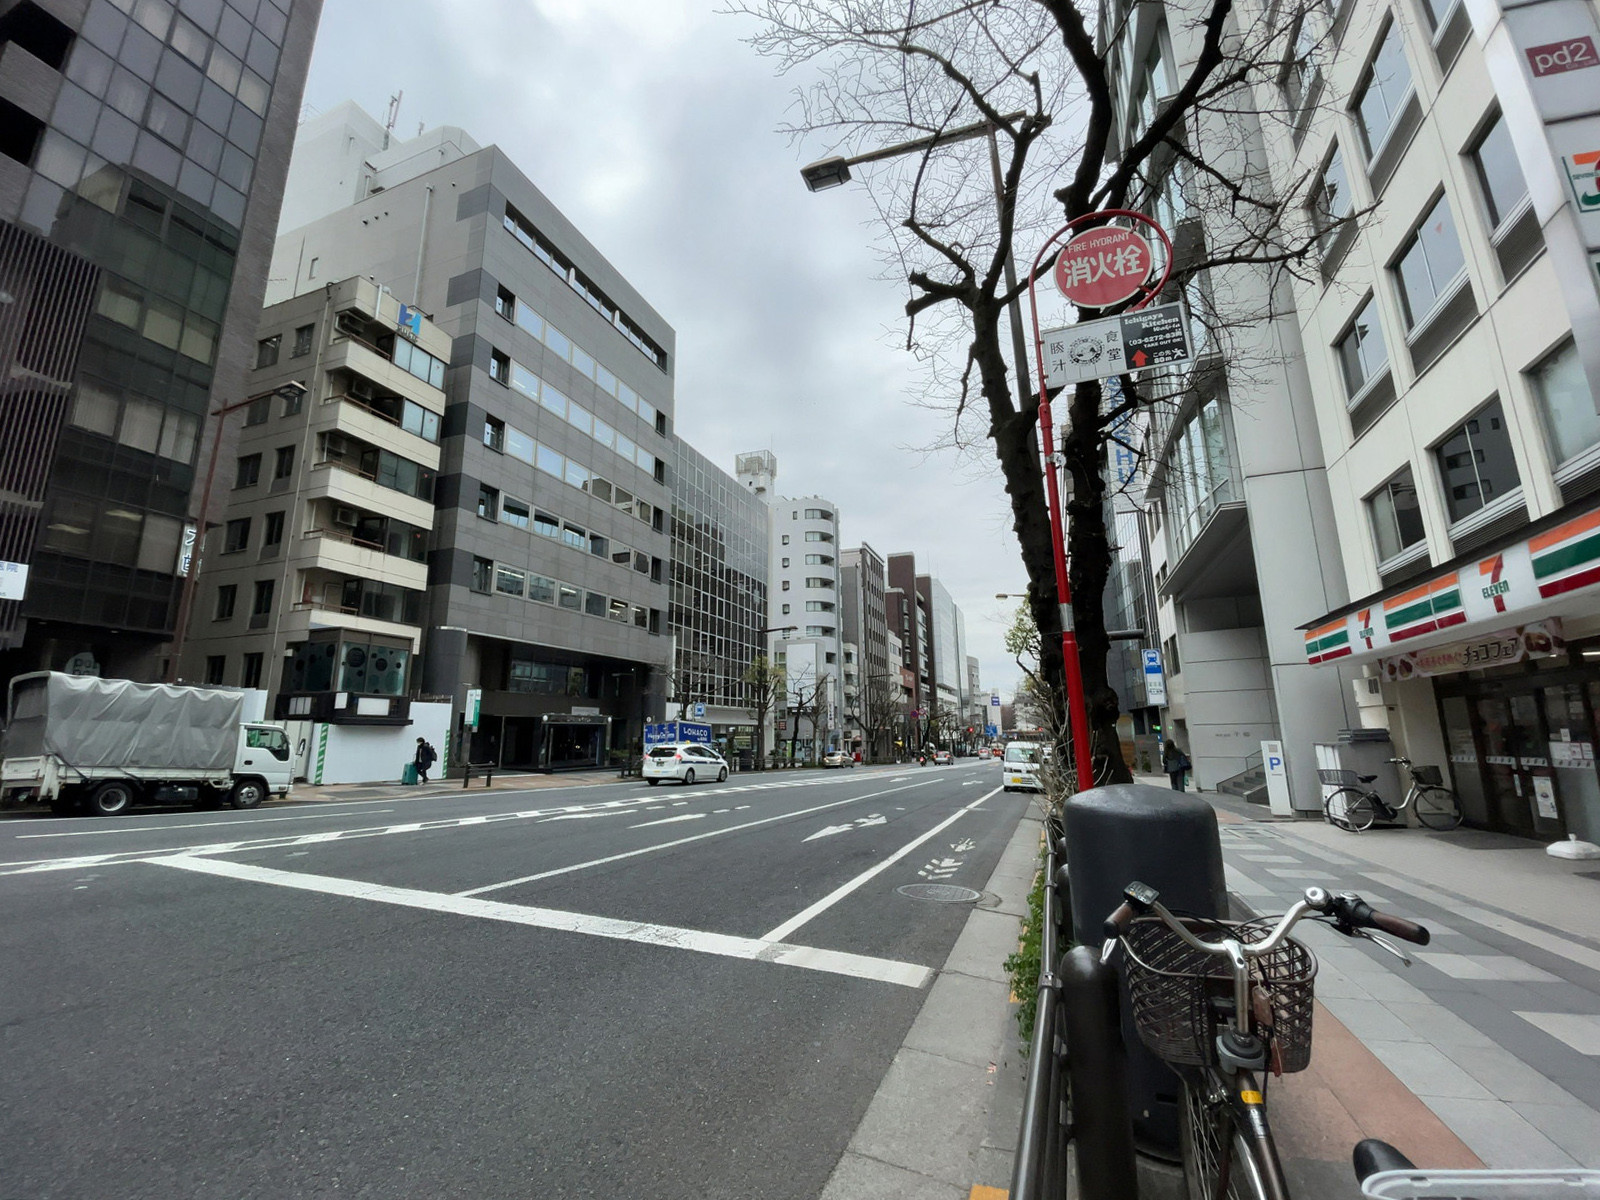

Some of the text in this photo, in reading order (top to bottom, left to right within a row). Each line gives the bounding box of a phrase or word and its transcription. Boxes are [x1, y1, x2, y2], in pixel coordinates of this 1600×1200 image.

[1535, 42, 1592, 73] pd2
[1068, 232, 1129, 253] FIRE HYDRANT
[1063, 244, 1144, 288] 消火栓
[1124, 313, 1163, 325] Ichigaya
[1141, 317, 1179, 328] Kitchen
[1104, 331, 1123, 362] 食堂
[1462, 637, 1519, 665] チョコフェア
[1269, 757, 1281, 771] P
